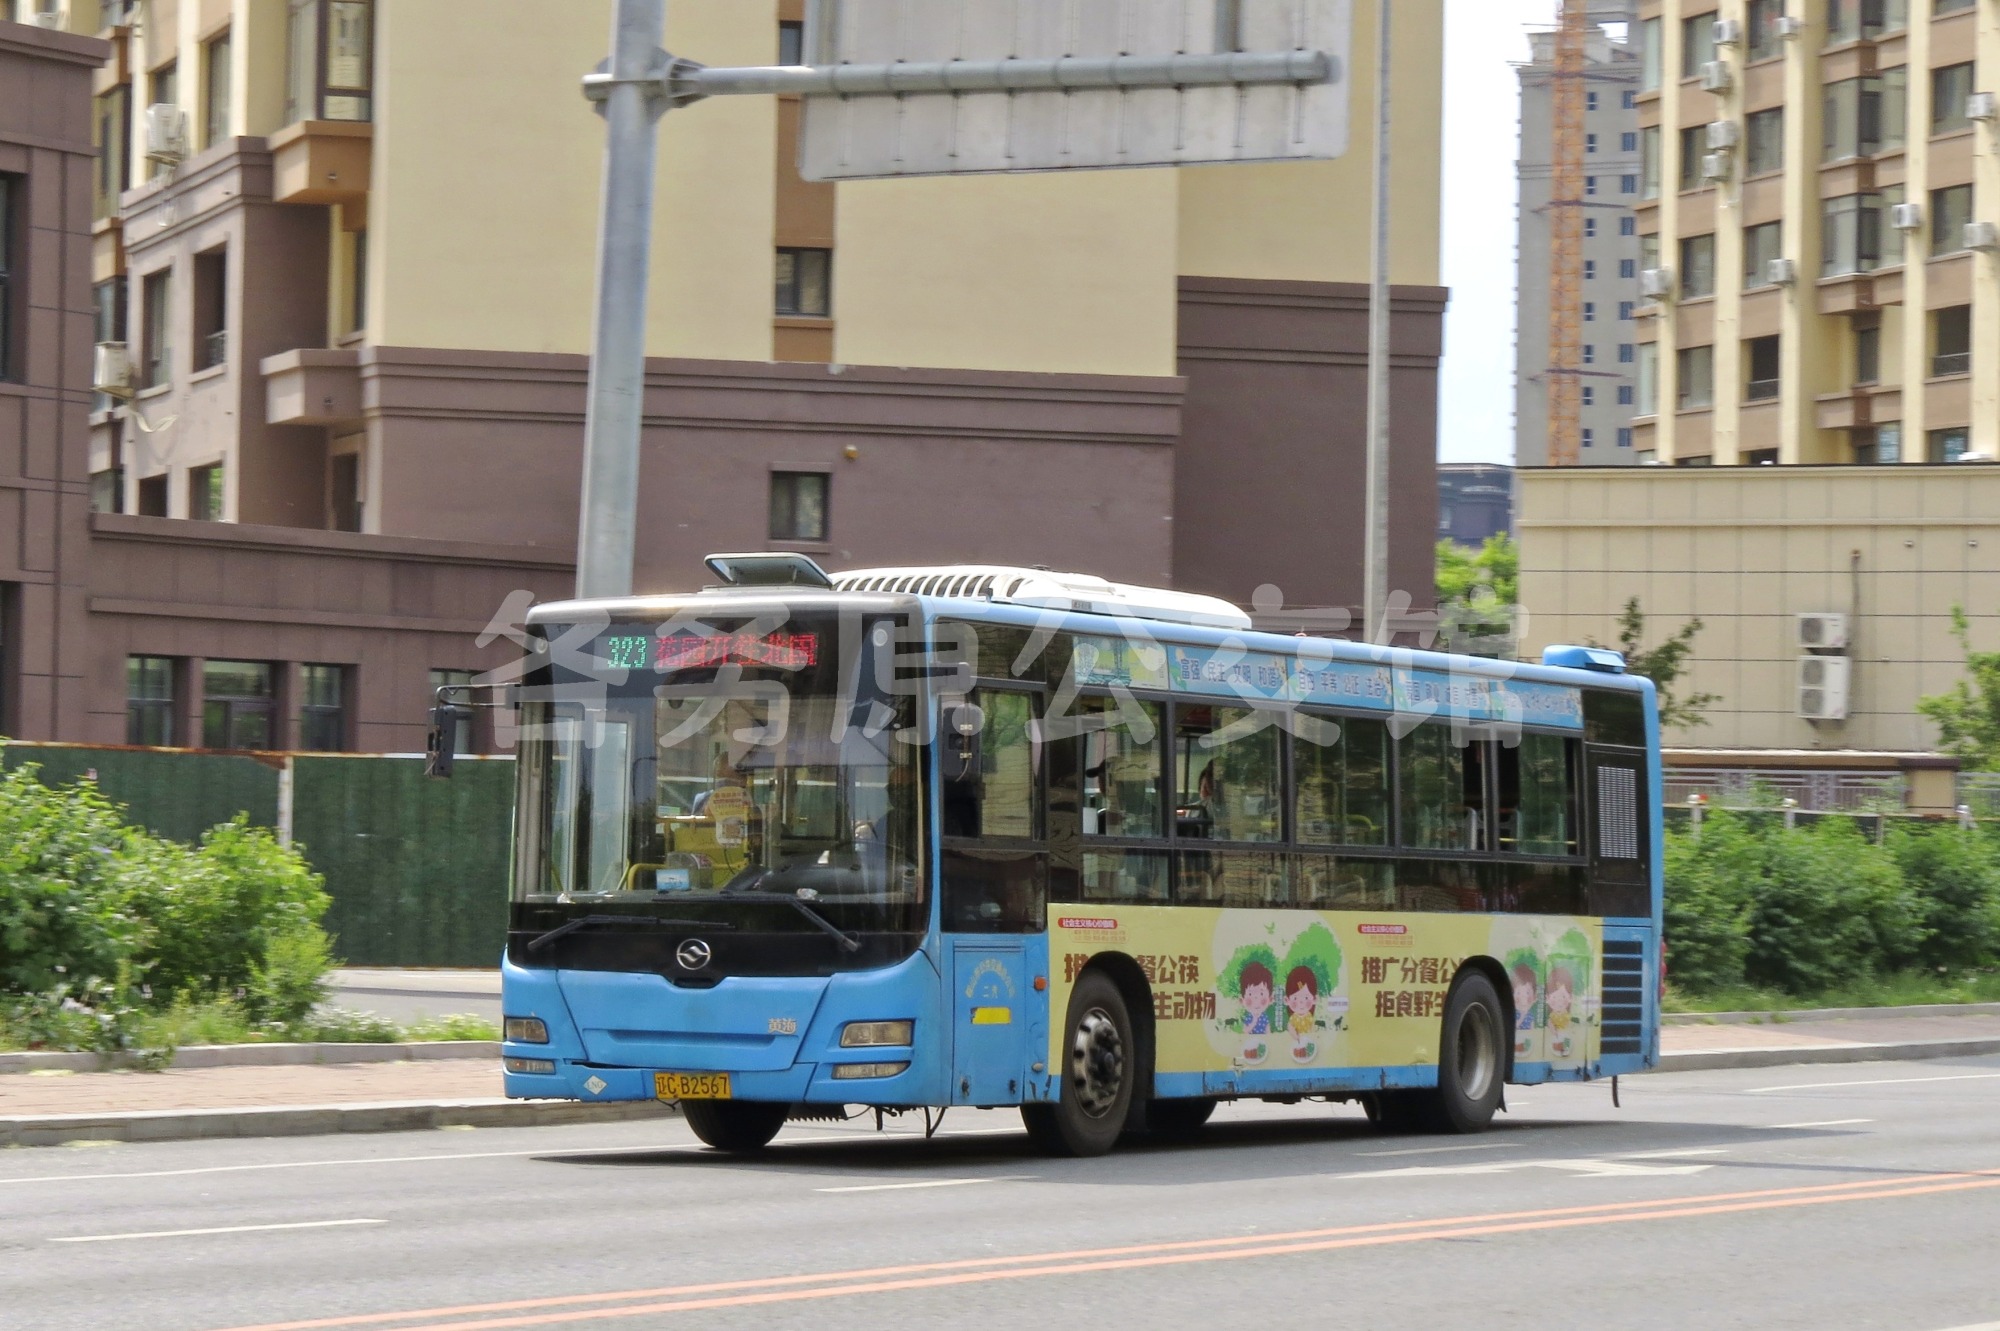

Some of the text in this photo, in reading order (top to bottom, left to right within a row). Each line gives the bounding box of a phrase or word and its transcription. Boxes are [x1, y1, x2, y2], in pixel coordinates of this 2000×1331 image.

[607, 636, 648, 669] 323
[1180, 658, 1201, 681] 富强
[1207, 661, 1227, 683] 民主
[1232, 663, 1252, 685] 文明
[1064, 953, 1200, 985] 推餐公筷
[1361, 956, 1463, 984] 推广分餐公
[768, 1018, 797, 1035] 黄海
